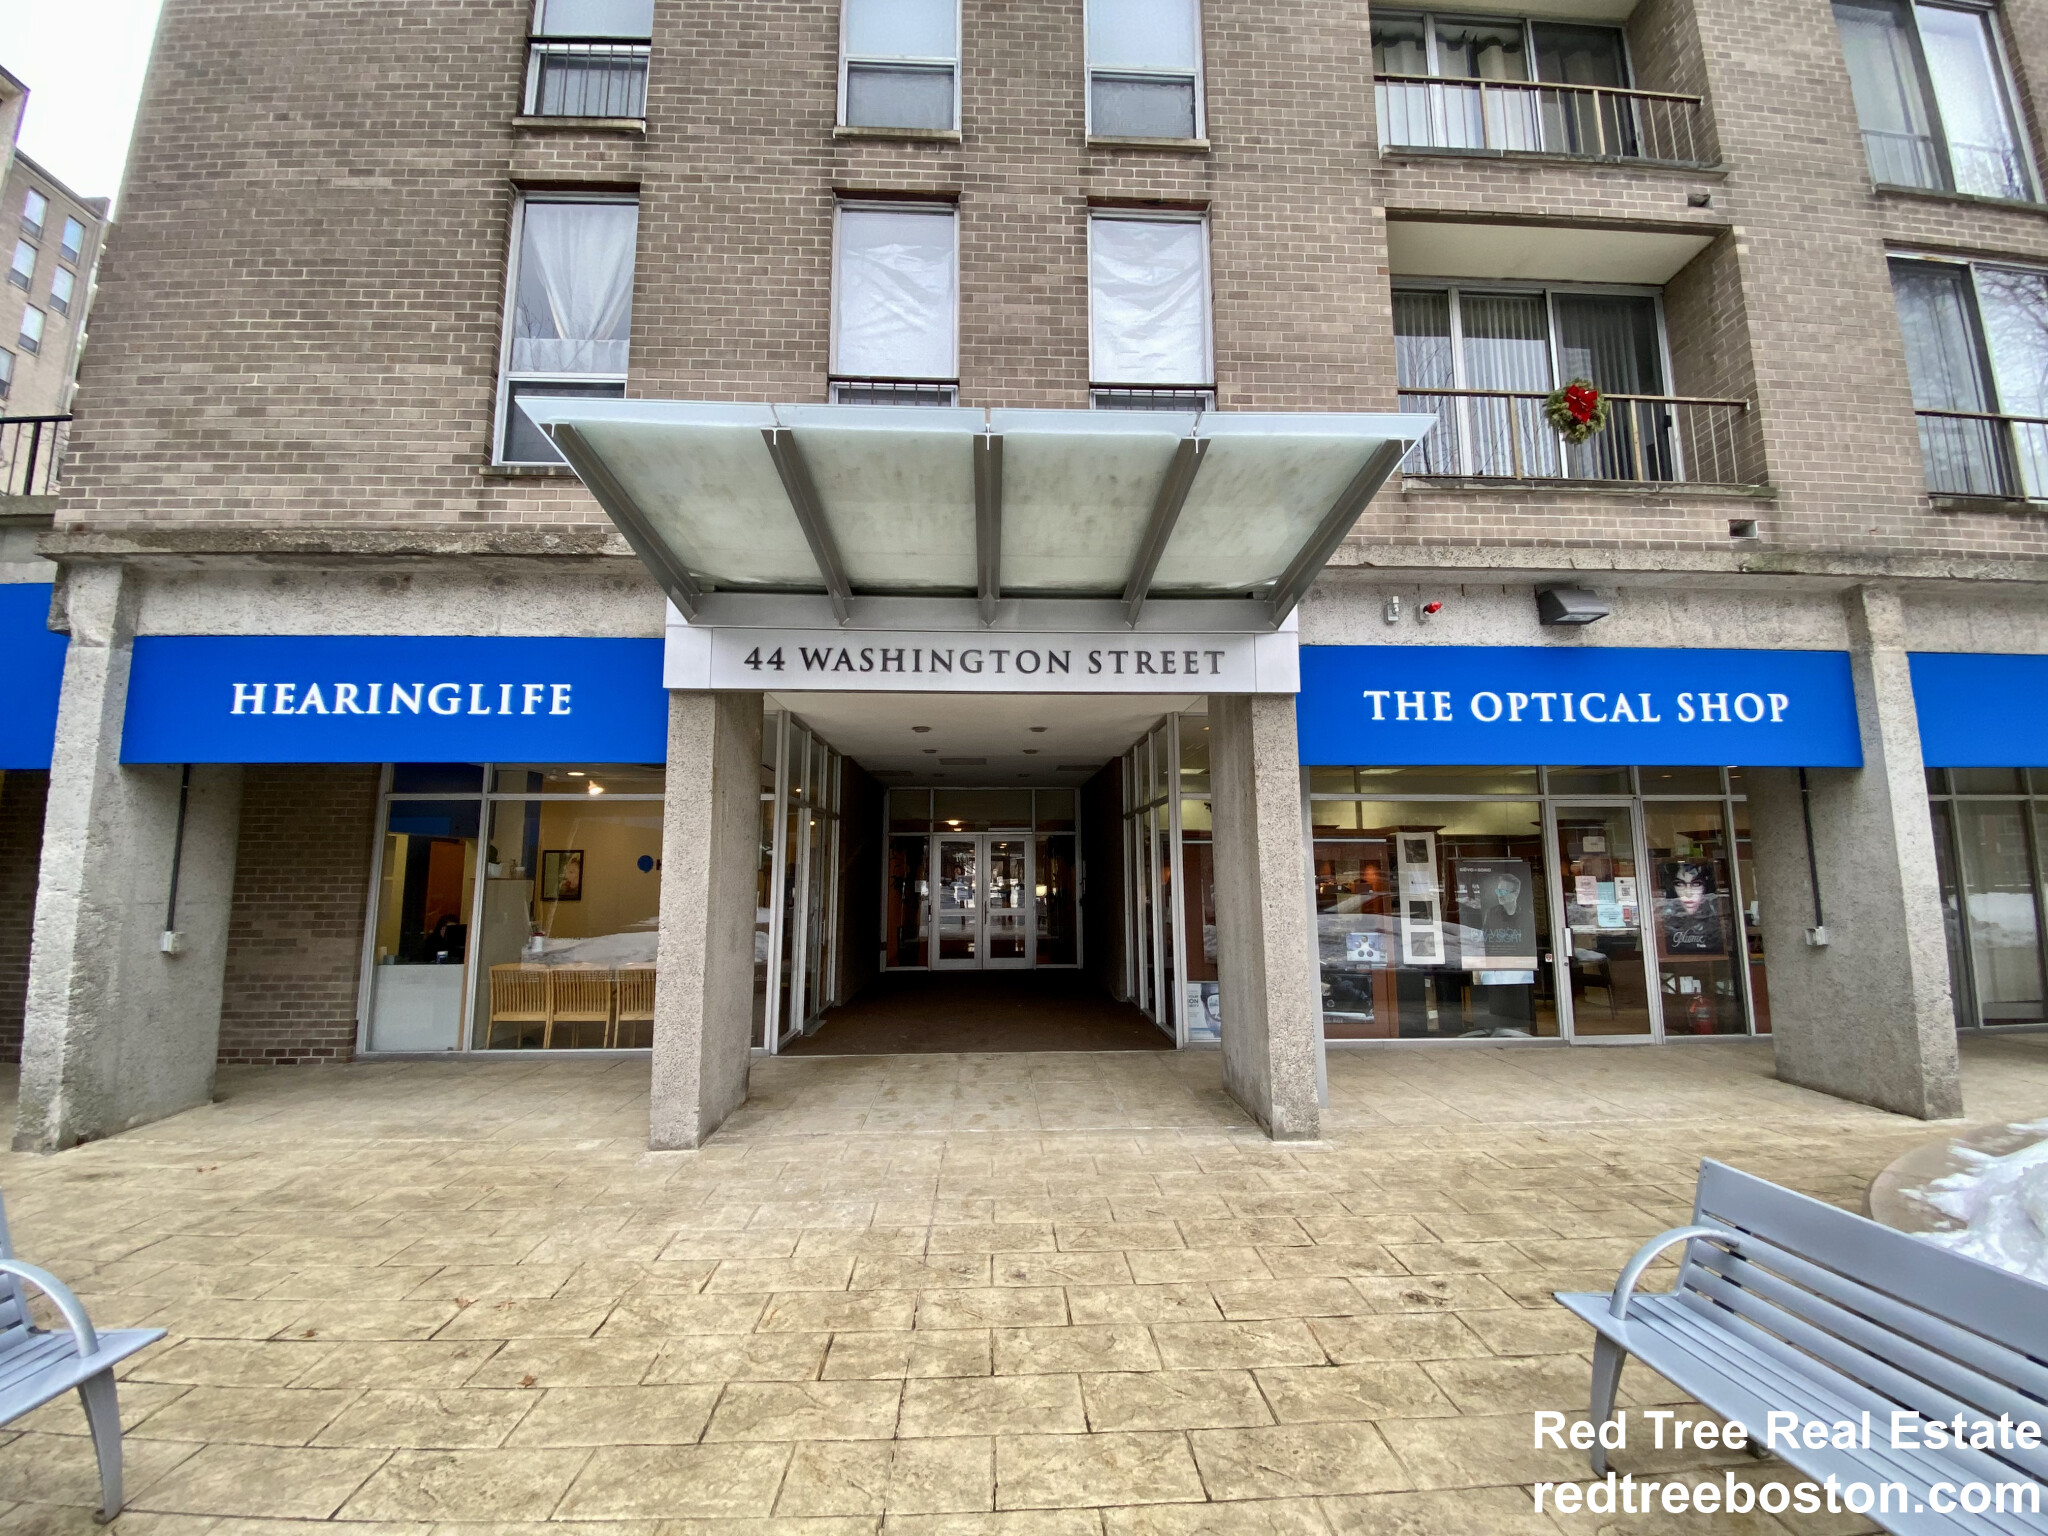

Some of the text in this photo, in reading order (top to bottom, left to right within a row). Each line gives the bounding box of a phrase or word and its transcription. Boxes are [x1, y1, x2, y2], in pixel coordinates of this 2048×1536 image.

[744, 647, 1225, 675] 44 WASHINGTON STREET
[230, 682, 572, 715] HEARINGLIFE
[1363, 690, 1789, 723] THE OPTICAL SHOP
